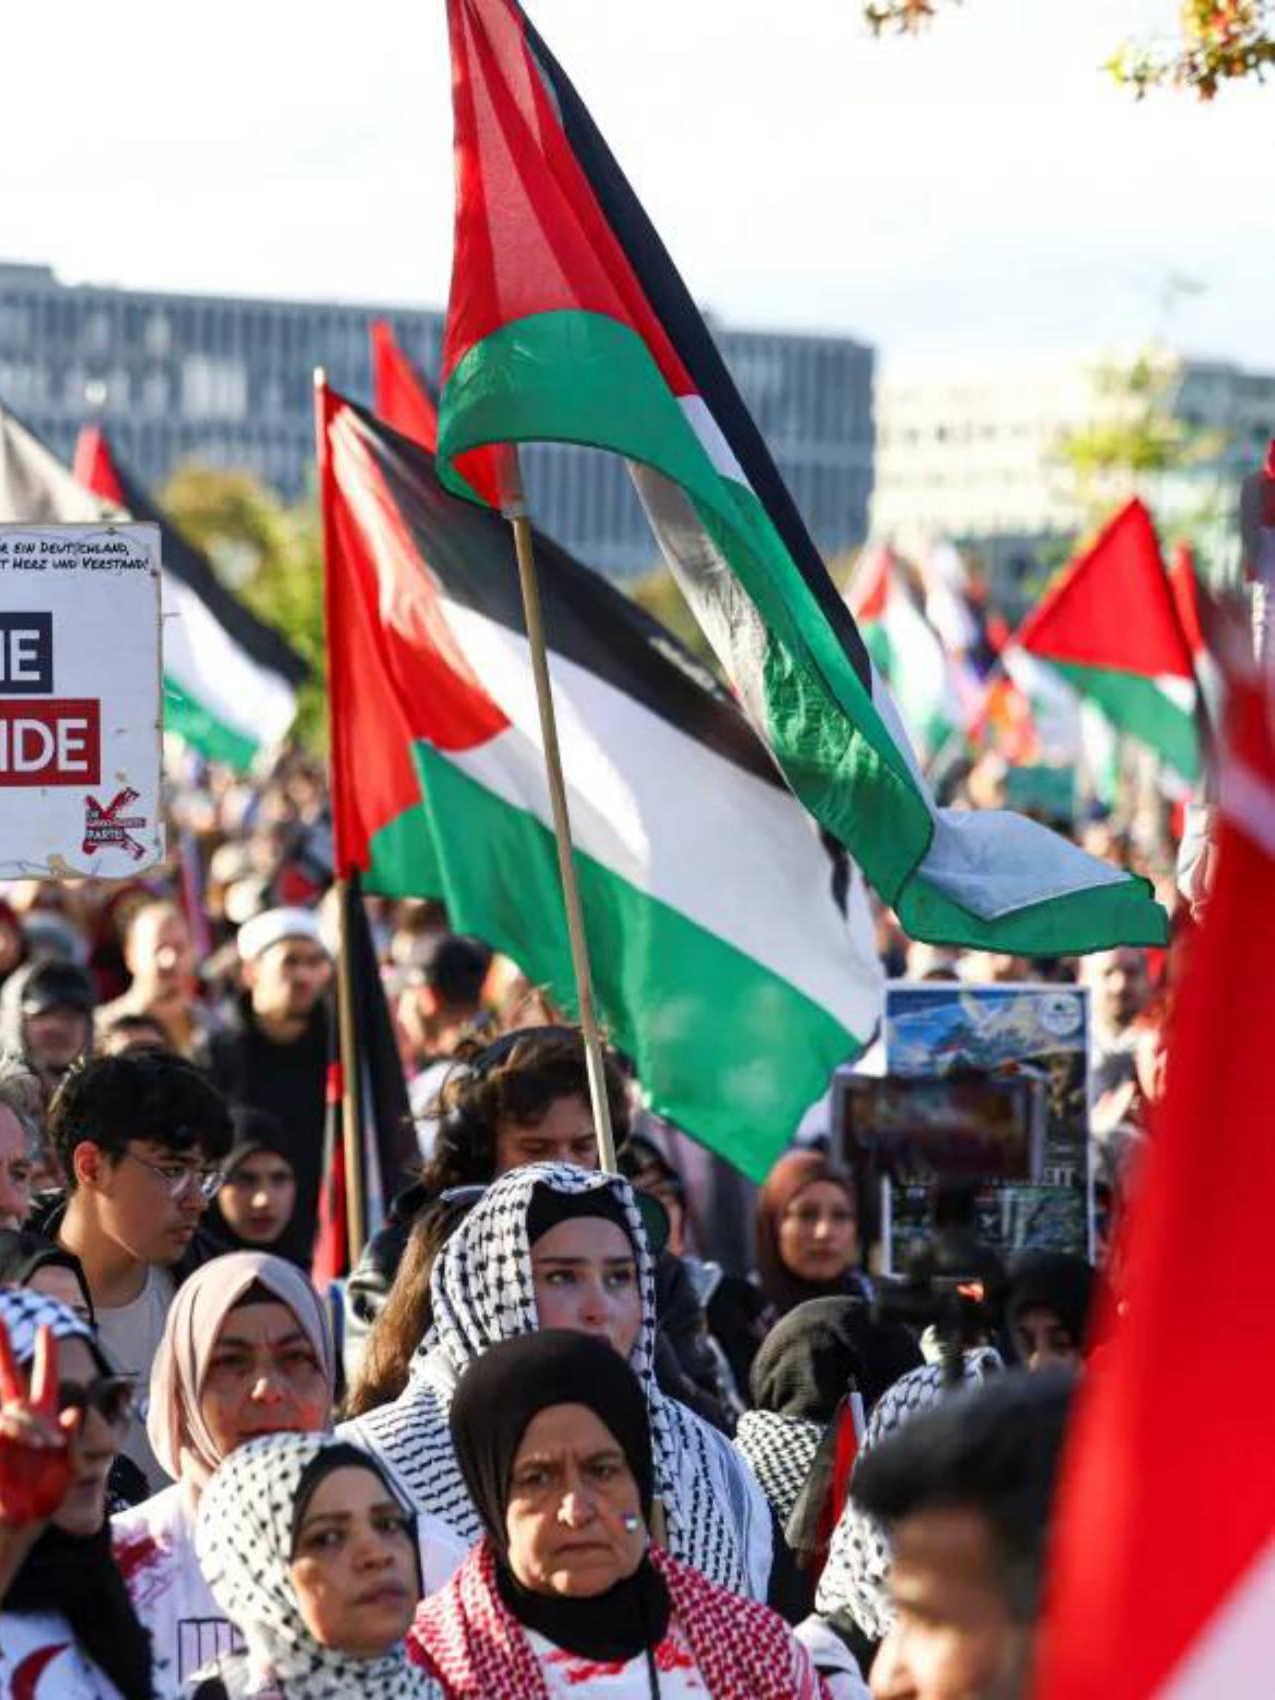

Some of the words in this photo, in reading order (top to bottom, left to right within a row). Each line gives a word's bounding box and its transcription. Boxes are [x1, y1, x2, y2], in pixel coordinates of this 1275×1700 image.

[13, 542, 36, 554] EIN
[13, 557, 48, 570] HERZ
[53, 558, 78, 570] UND
